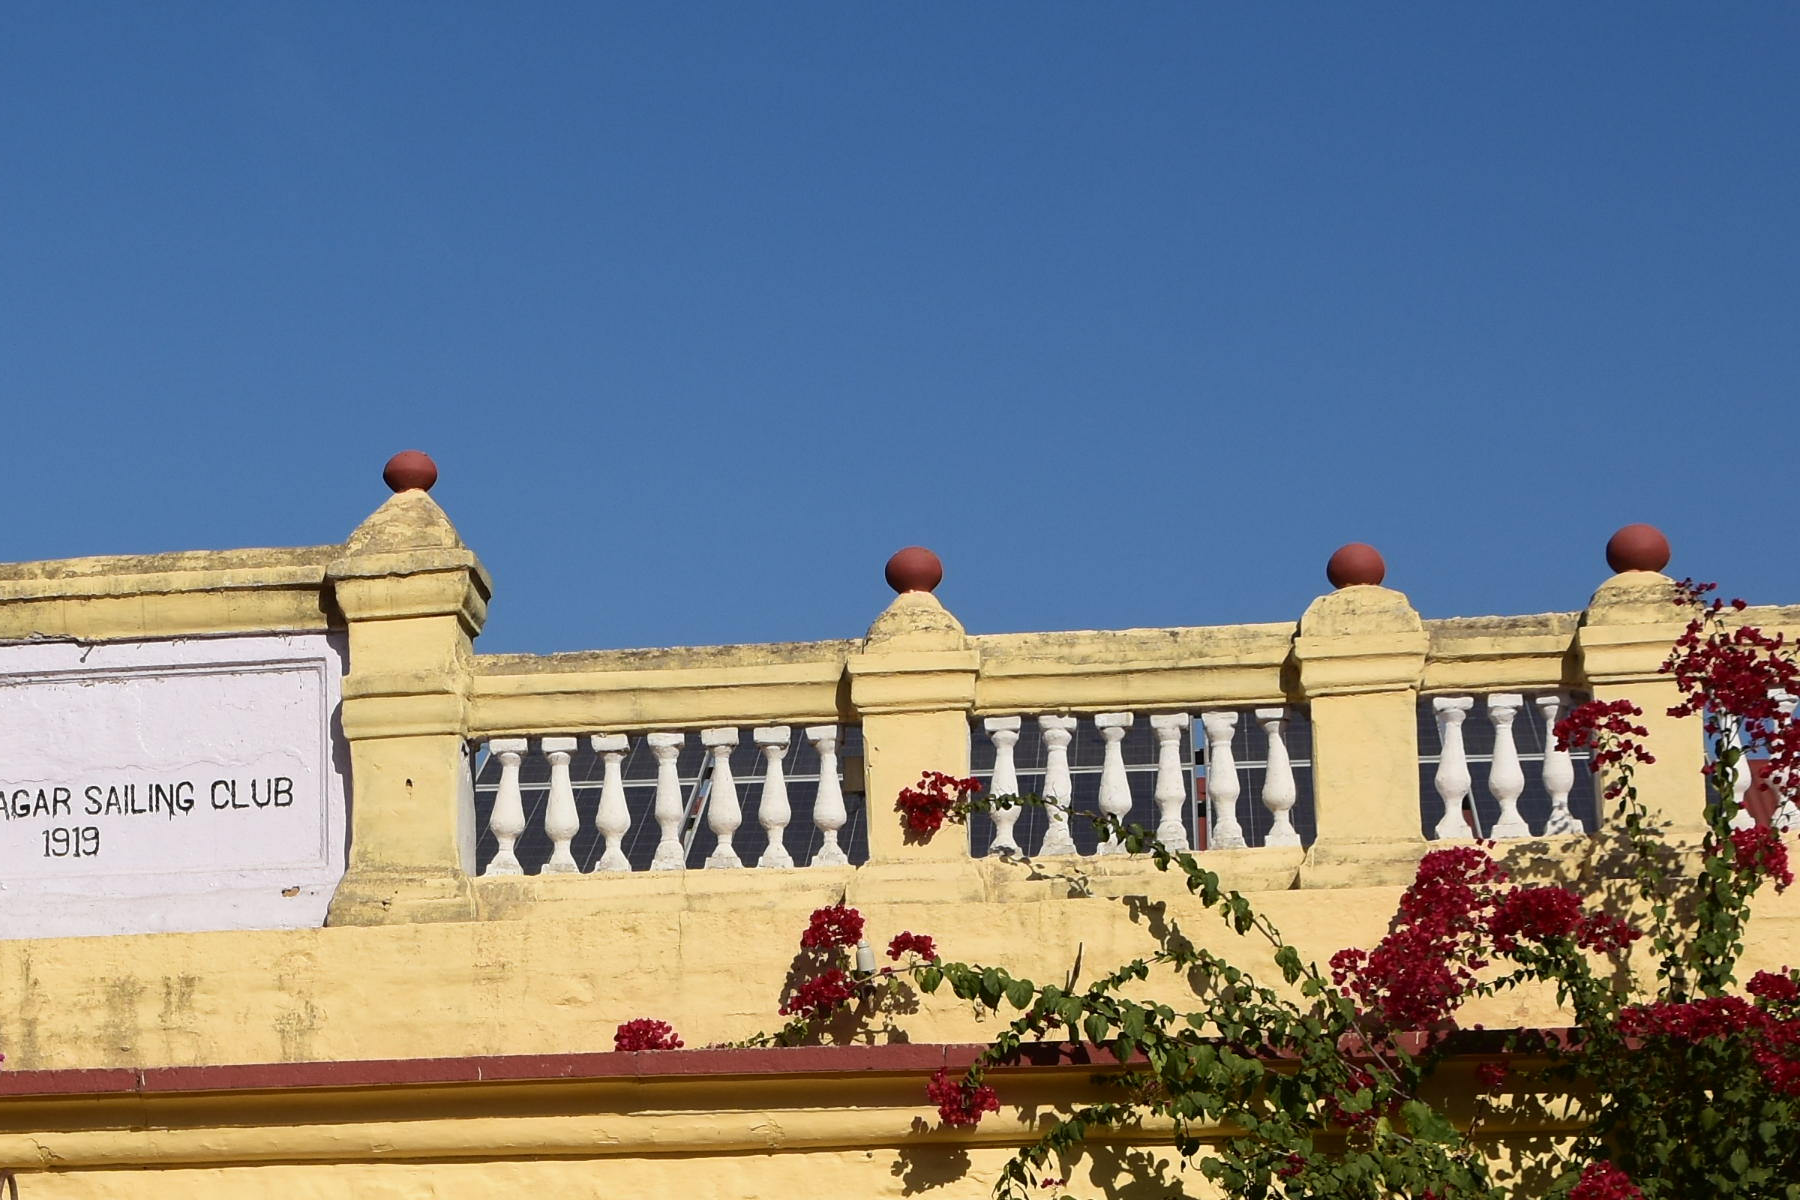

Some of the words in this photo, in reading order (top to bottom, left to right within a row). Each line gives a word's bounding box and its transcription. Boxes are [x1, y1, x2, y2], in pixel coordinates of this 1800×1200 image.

[84, 781, 195, 821] SAILING
[210, 776, 294, 810] CLUB
[42, 827, 100, 858] 1919
